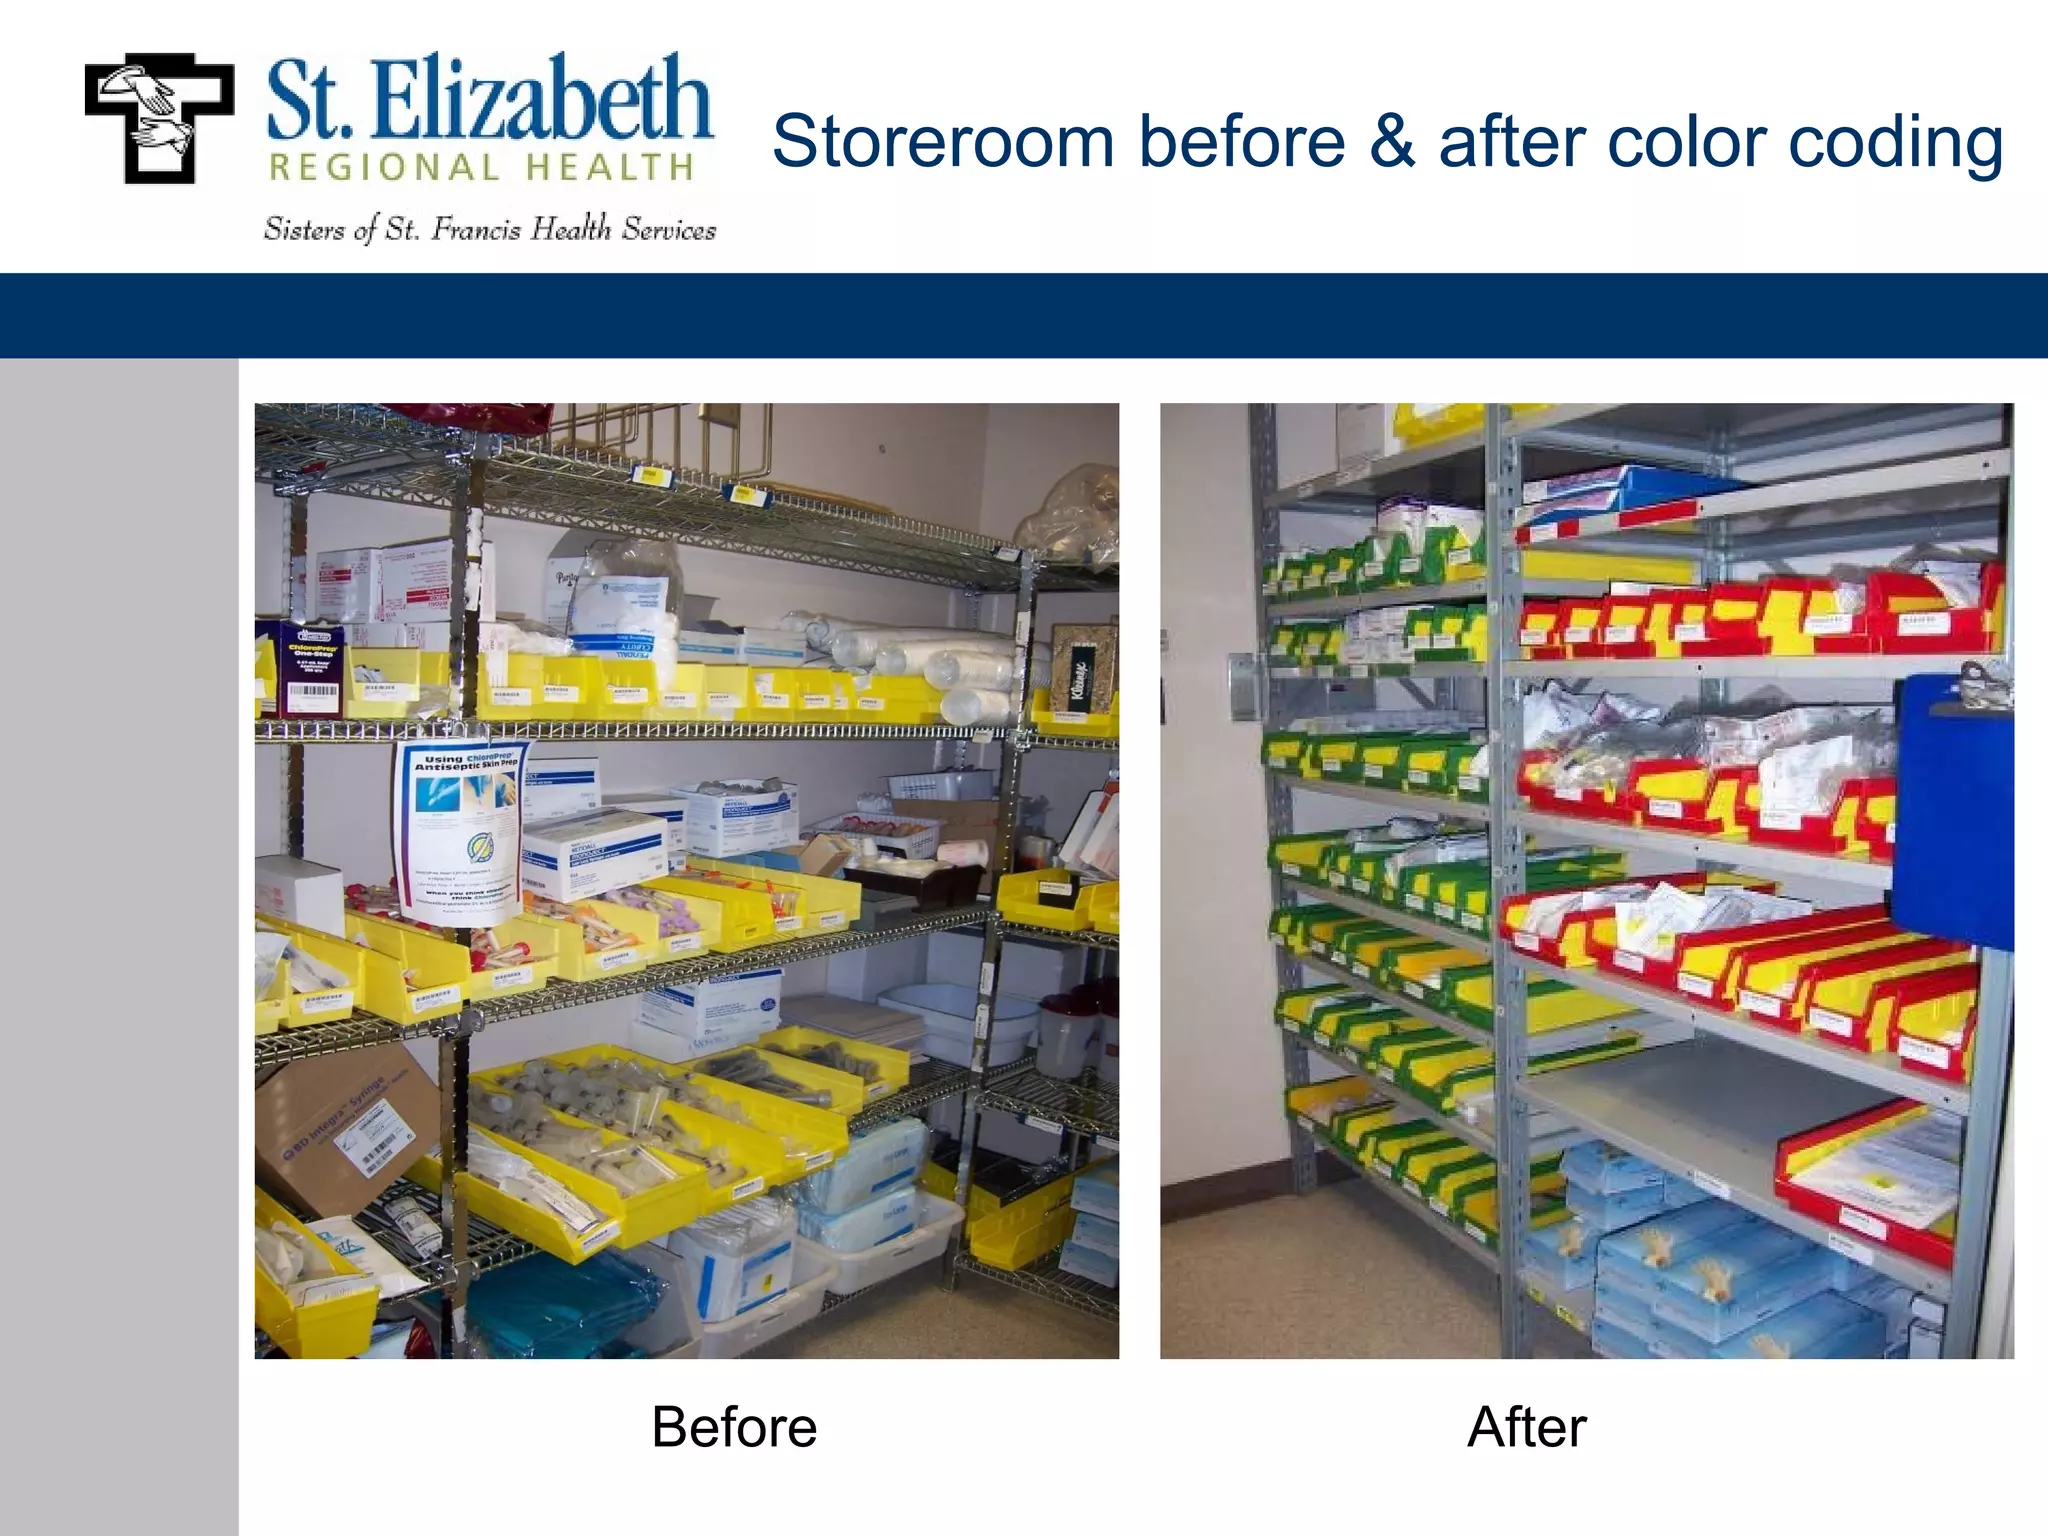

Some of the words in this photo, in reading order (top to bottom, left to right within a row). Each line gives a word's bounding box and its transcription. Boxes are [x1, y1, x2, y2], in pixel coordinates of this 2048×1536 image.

[1071, 662, 1088, 700] Kleenex
[415, 763, 480, 771] Antiseptic
[483, 759, 500, 768] Skin
[501, 758, 518, 767] Prep
[425, 755, 463, 764] Using
[292, 1137, 309, 1153] BD
[349, 1076, 386, 1107] Syringe
